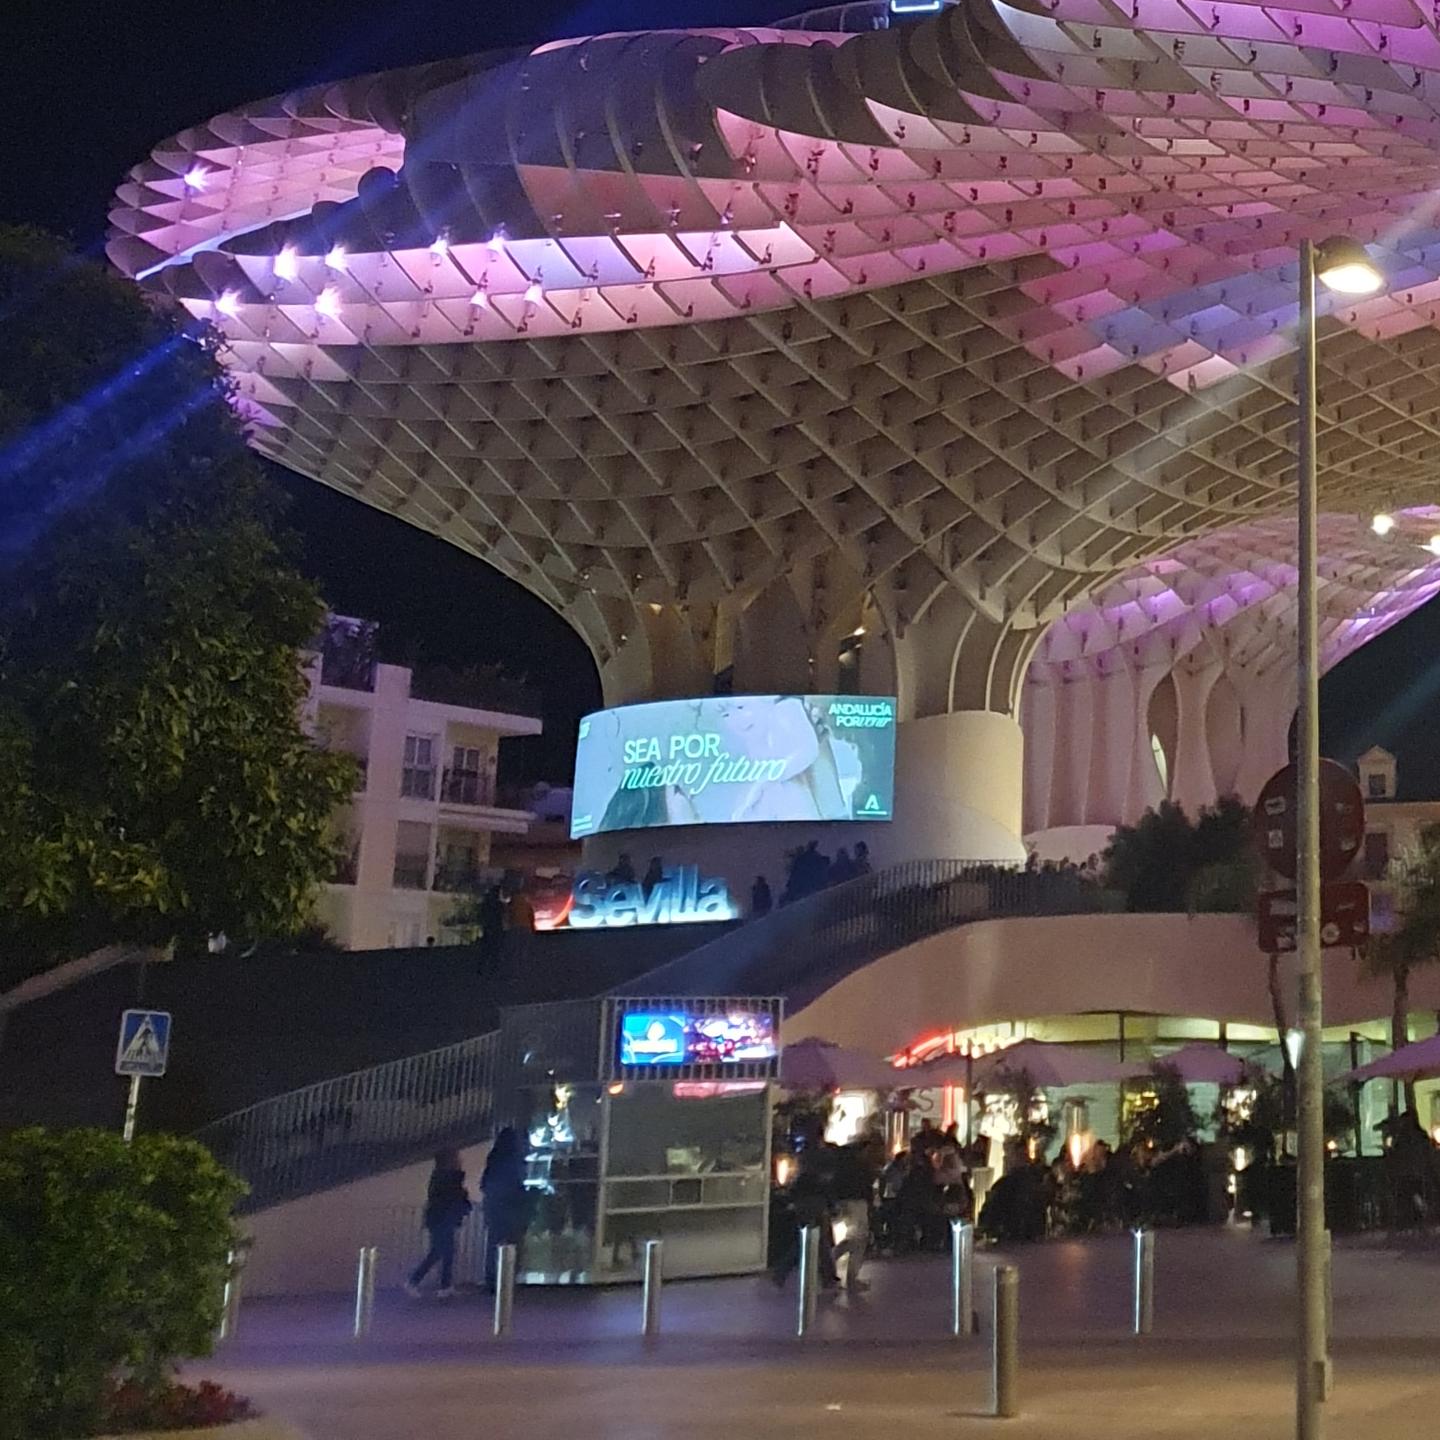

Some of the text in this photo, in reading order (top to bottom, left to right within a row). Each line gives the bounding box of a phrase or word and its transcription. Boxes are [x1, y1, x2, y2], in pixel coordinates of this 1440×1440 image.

[828, 702, 892, 716] ANDALUCÍA
[623, 733, 721, 764] SEA POR
[620, 751, 789, 796] nuestro futuro
[568, 863, 738, 928] Sevilla
